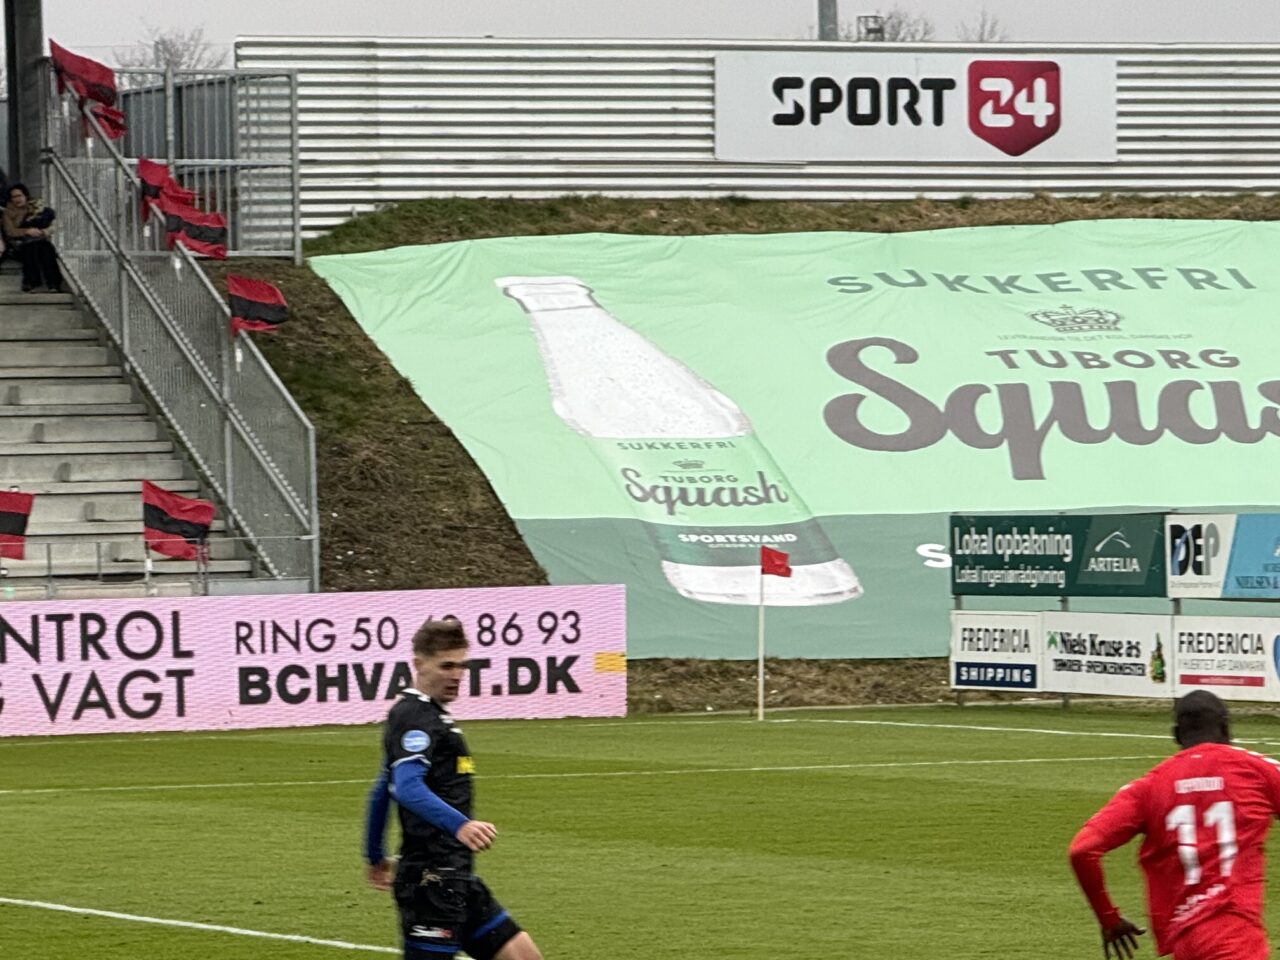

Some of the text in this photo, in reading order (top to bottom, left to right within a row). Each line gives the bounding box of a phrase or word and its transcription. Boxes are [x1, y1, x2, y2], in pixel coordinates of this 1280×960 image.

[772, 76, 1055, 128] SPORT 24
[828, 267, 1257, 295] SUKKERFRI
[985, 349, 1240, 369] TUBORG
[617, 441, 737, 451] SUKKERFRI
[621, 467, 789, 516] Squash
[659, 475, 739, 484] TUBORG
[678, 533, 798, 543] SPORTSVAND
[954, 527, 992, 556] Lokal
[995, 527, 1073, 562] opbakning
[1088, 558, 1141, 572] ARTELIA
[235, 619, 336, 654] RING
[350, 617, 399, 651] 50
[477, 611, 523, 648] 86
[537, 611, 581, 645] 93
[961, 627, 1031, 654] FREDERICIA
[1178, 631, 1265, 655] FREDERICIA
[960, 666, 1032, 683] SHIPPING
[32, 655, 581, 723] VAGT BCHVAT.DK
[1165, 801, 1239, 886] 11
